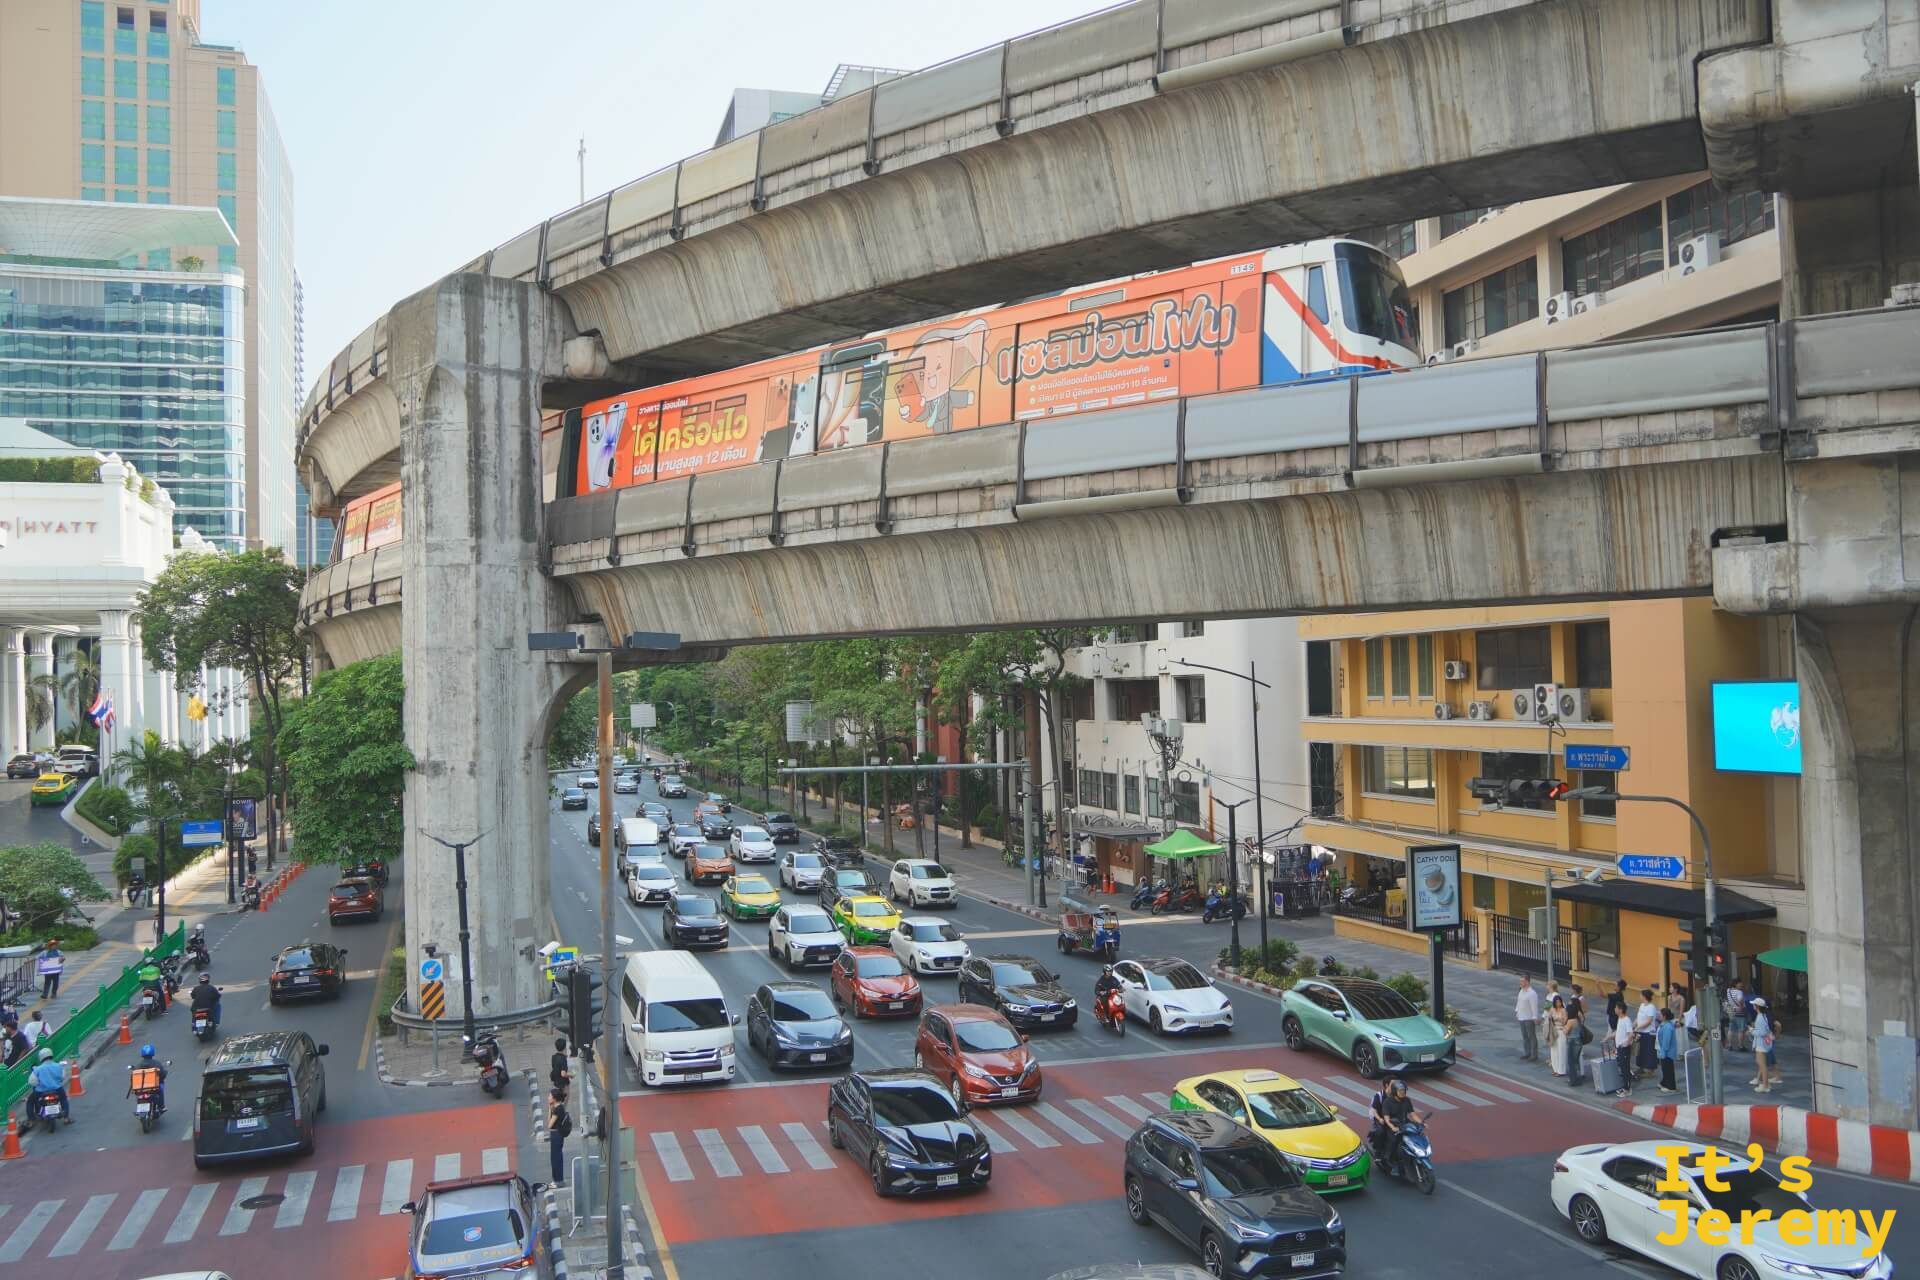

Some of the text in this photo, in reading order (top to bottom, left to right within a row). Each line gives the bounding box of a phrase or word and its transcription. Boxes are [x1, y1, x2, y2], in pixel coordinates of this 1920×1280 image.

[632, 406, 748, 457] ได้เครื่องไว
[707, 451, 720, 464] 12
[720, 445, 747, 461] เดือน
[24, 522, 98, 534] HYATT
[1416, 855, 1457, 864] CATHY DOLL
